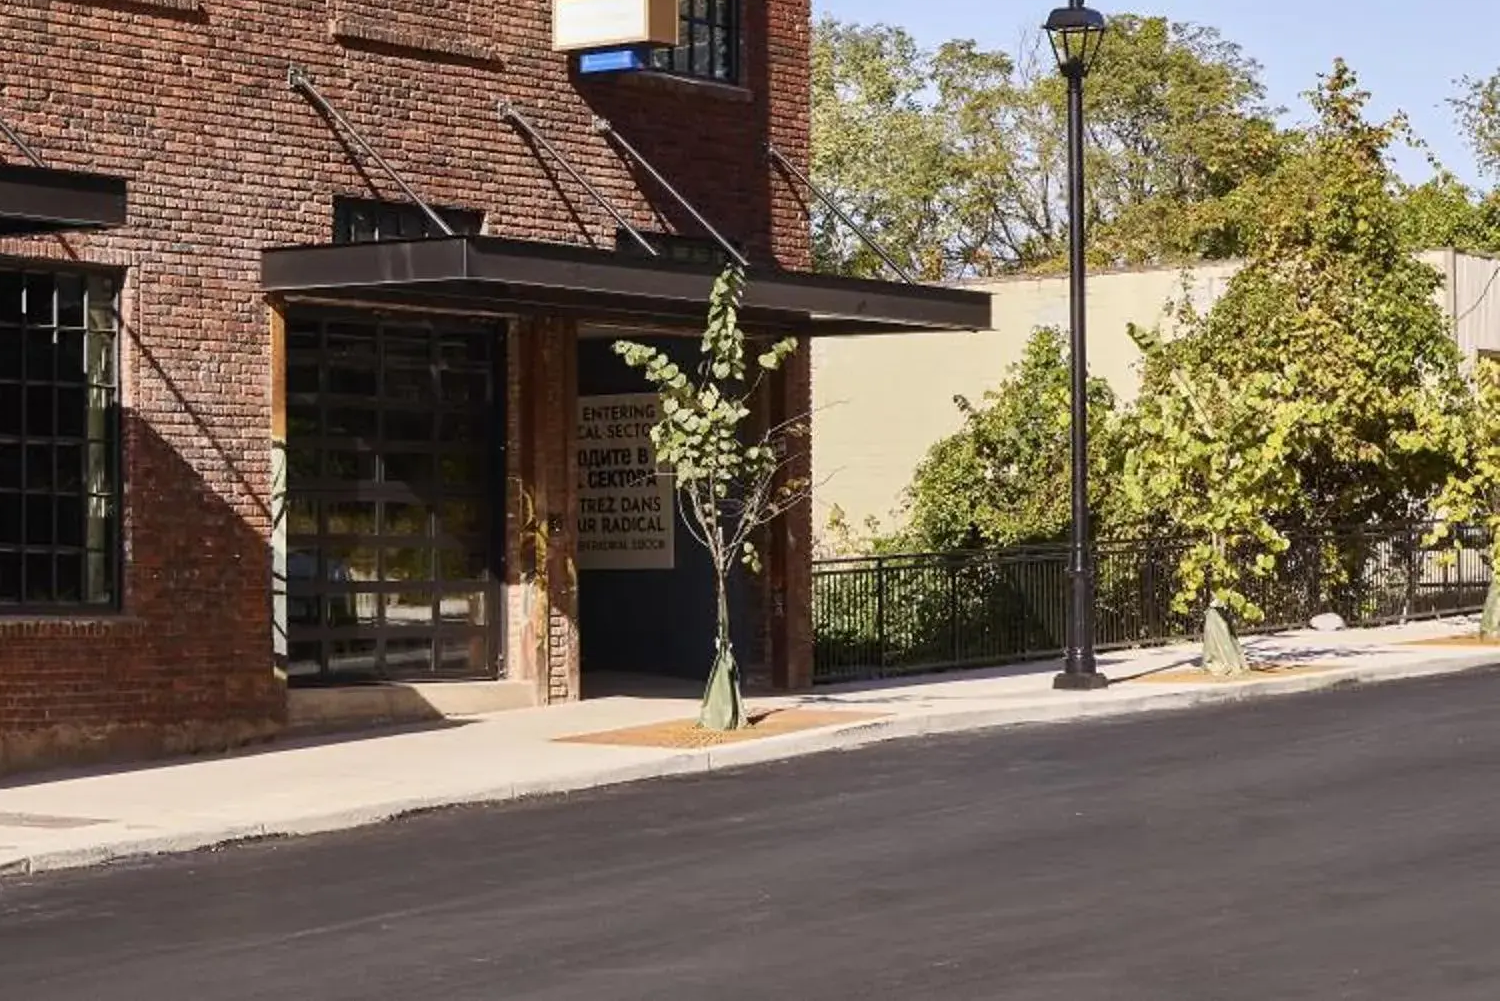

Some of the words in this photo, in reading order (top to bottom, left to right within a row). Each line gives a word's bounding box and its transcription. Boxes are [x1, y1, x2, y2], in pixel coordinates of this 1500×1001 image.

[581, 404, 656, 421] ENTERING
[606, 421, 655, 438] SECTO
[621, 496, 661, 513] DANS
[602, 516, 666, 533] RADICAL
